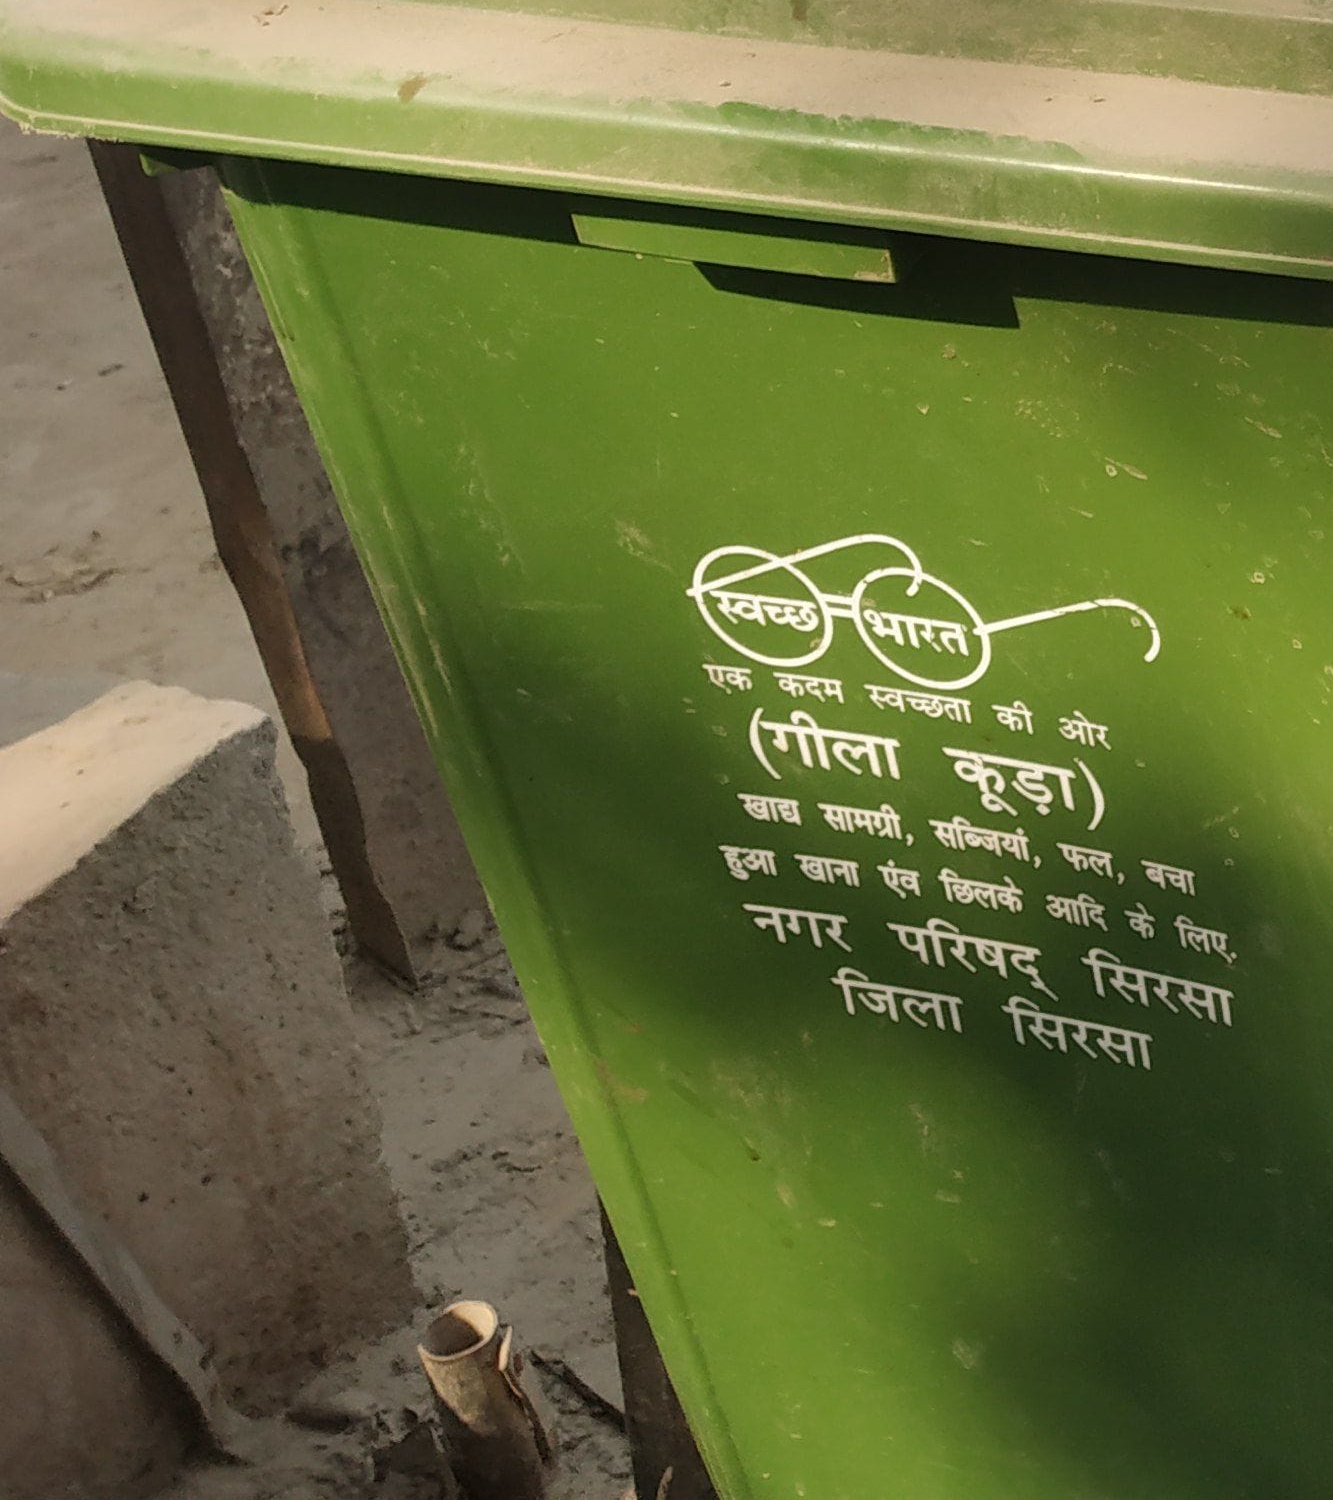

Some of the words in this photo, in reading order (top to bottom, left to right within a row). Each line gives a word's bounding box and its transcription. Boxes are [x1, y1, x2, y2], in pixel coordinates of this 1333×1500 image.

[712, 588, 821, 634] स्वच्छ
[862, 608, 969, 657] भारत
[702, 664, 753, 695] एक
[772, 671, 844, 704] कदम
[863, 684, 972, 724] स्वच्छता
[991, 700, 1034, 735] की
[1059, 710, 1111, 750] ओर
[718, 845, 778, 881] हुआ
[793, 854, 860, 887] खाना
[937, 867, 1024, 913] छिलके
[1045, 893, 1108, 931] आदि
[1124, 902, 1155, 939] के
[1140, 859, 1195, 896] बचा
[742, 903, 852, 952] नगर
[1080, 947, 1234, 1027] सिरसा
[830, 966, 963, 1033] जिला
[1001, 995, 1153, 1070] सिरसा
